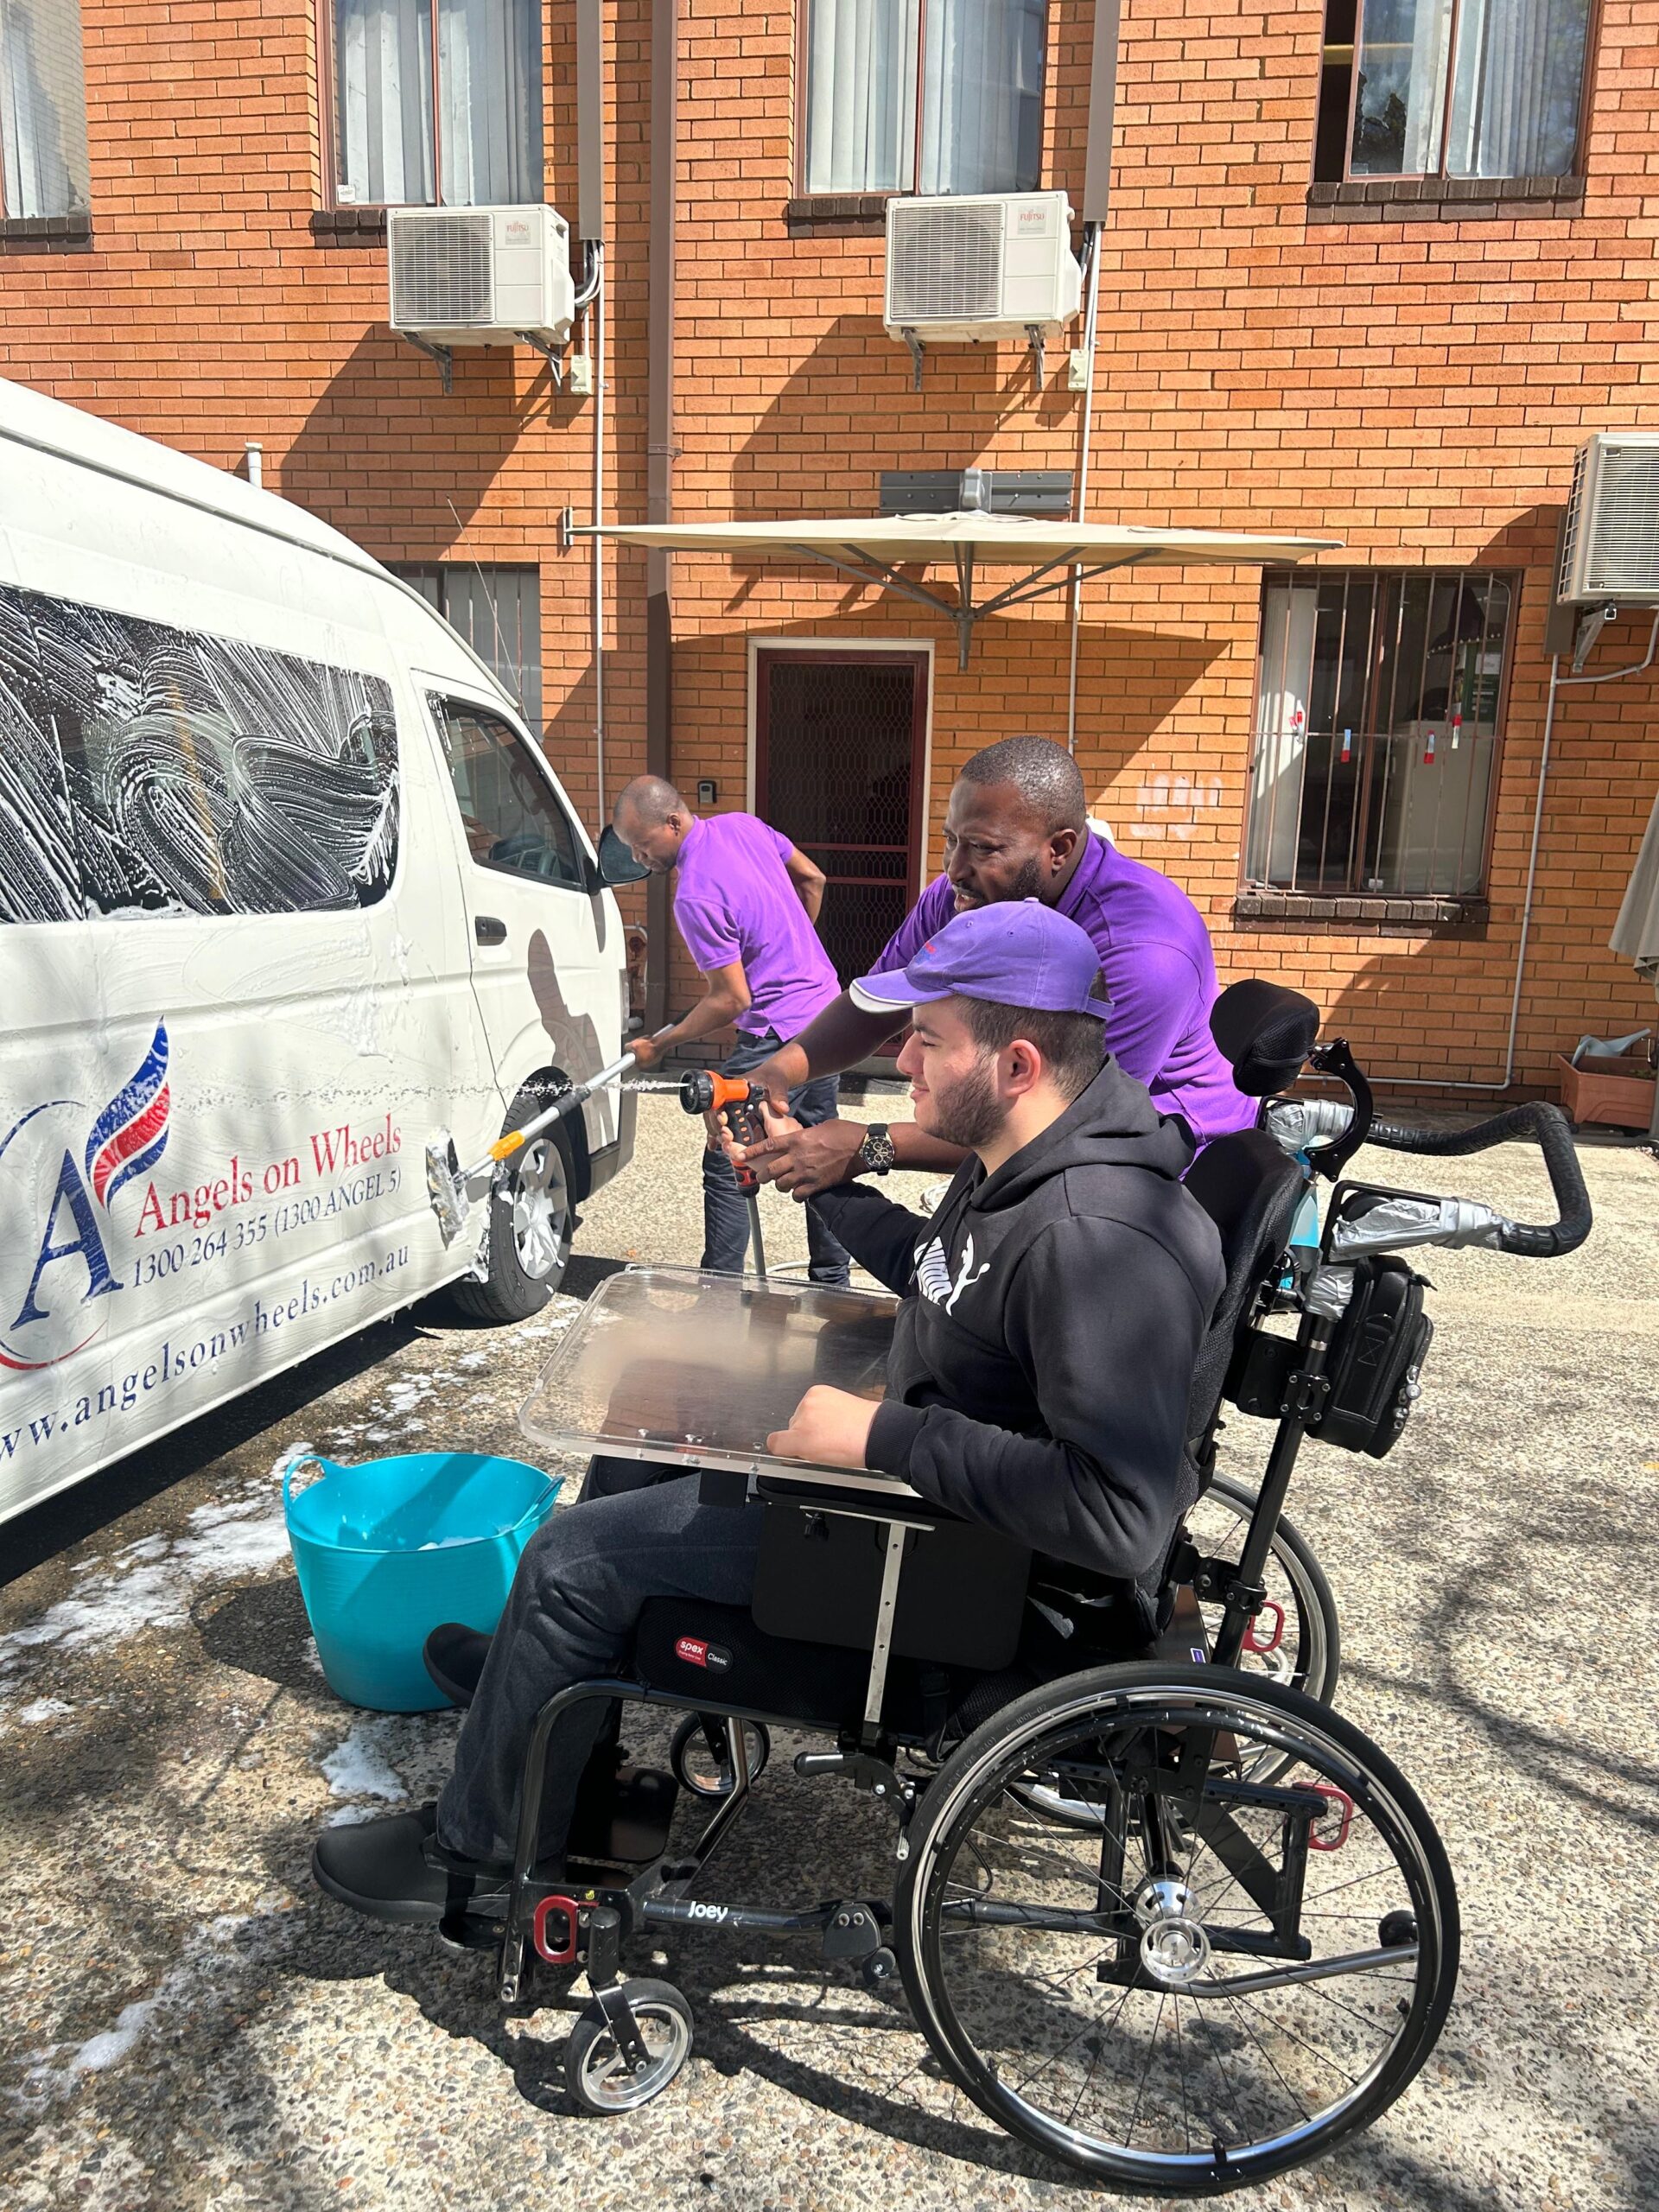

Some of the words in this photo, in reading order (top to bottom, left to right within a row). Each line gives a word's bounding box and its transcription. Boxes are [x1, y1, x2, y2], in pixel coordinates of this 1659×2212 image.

[1020, 212, 1045, 222] FUJITSU
[133, 1155, 253, 1237] Angels
[263, 1157, 302, 1195] on
[309, 1113, 402, 1178] Wheels
[132, 1244, 184, 1288] 1300
[190, 1229, 228, 1267] 264
[233, 1214, 267, 1250] 355
[274, 1195, 321, 1239] (1300
[323, 1173, 385, 1217] ANGEL
[387, 1166, 402, 1196] 5)
[680, 1641, 704, 1655] spex
[708, 1652, 728, 1666] Classic
[688, 1901, 728, 1923] Joey
